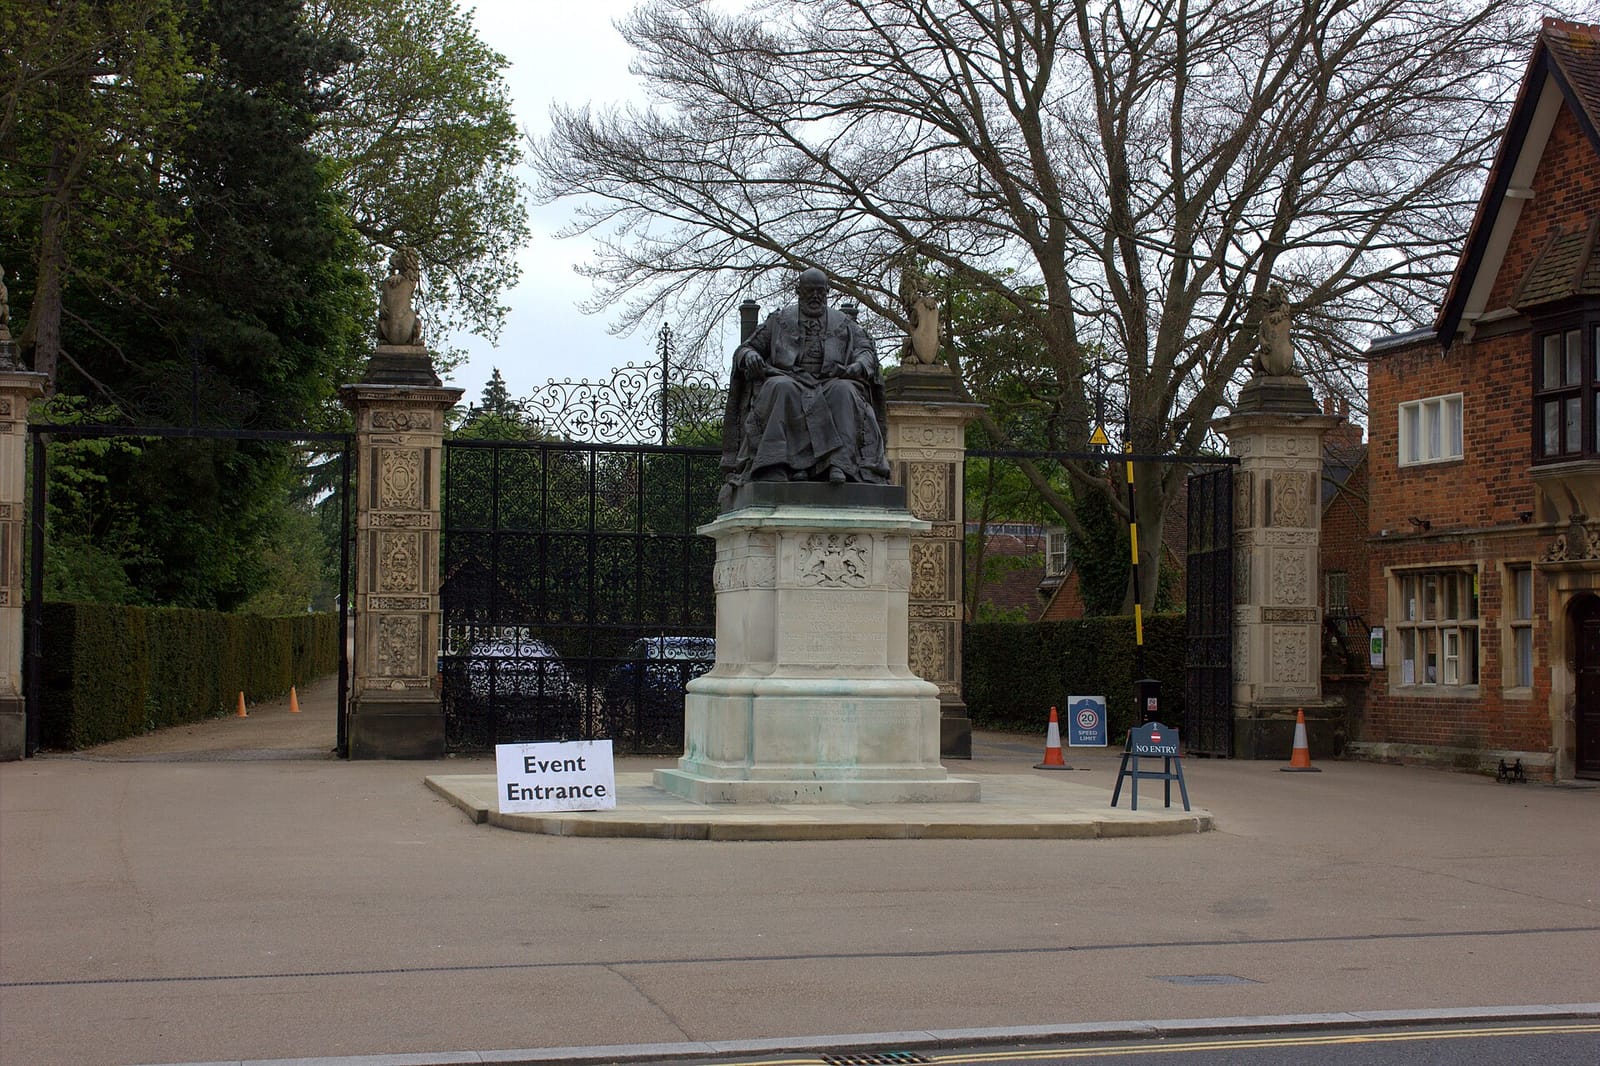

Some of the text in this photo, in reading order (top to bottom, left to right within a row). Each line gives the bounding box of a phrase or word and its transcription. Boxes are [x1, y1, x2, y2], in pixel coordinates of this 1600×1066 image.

[1081, 714, 1094, 722] 20
[1136, 745, 1177, 754] NO ENTRY
[523, 755, 587, 774] Event
[507, 783, 606, 801] Entrance
